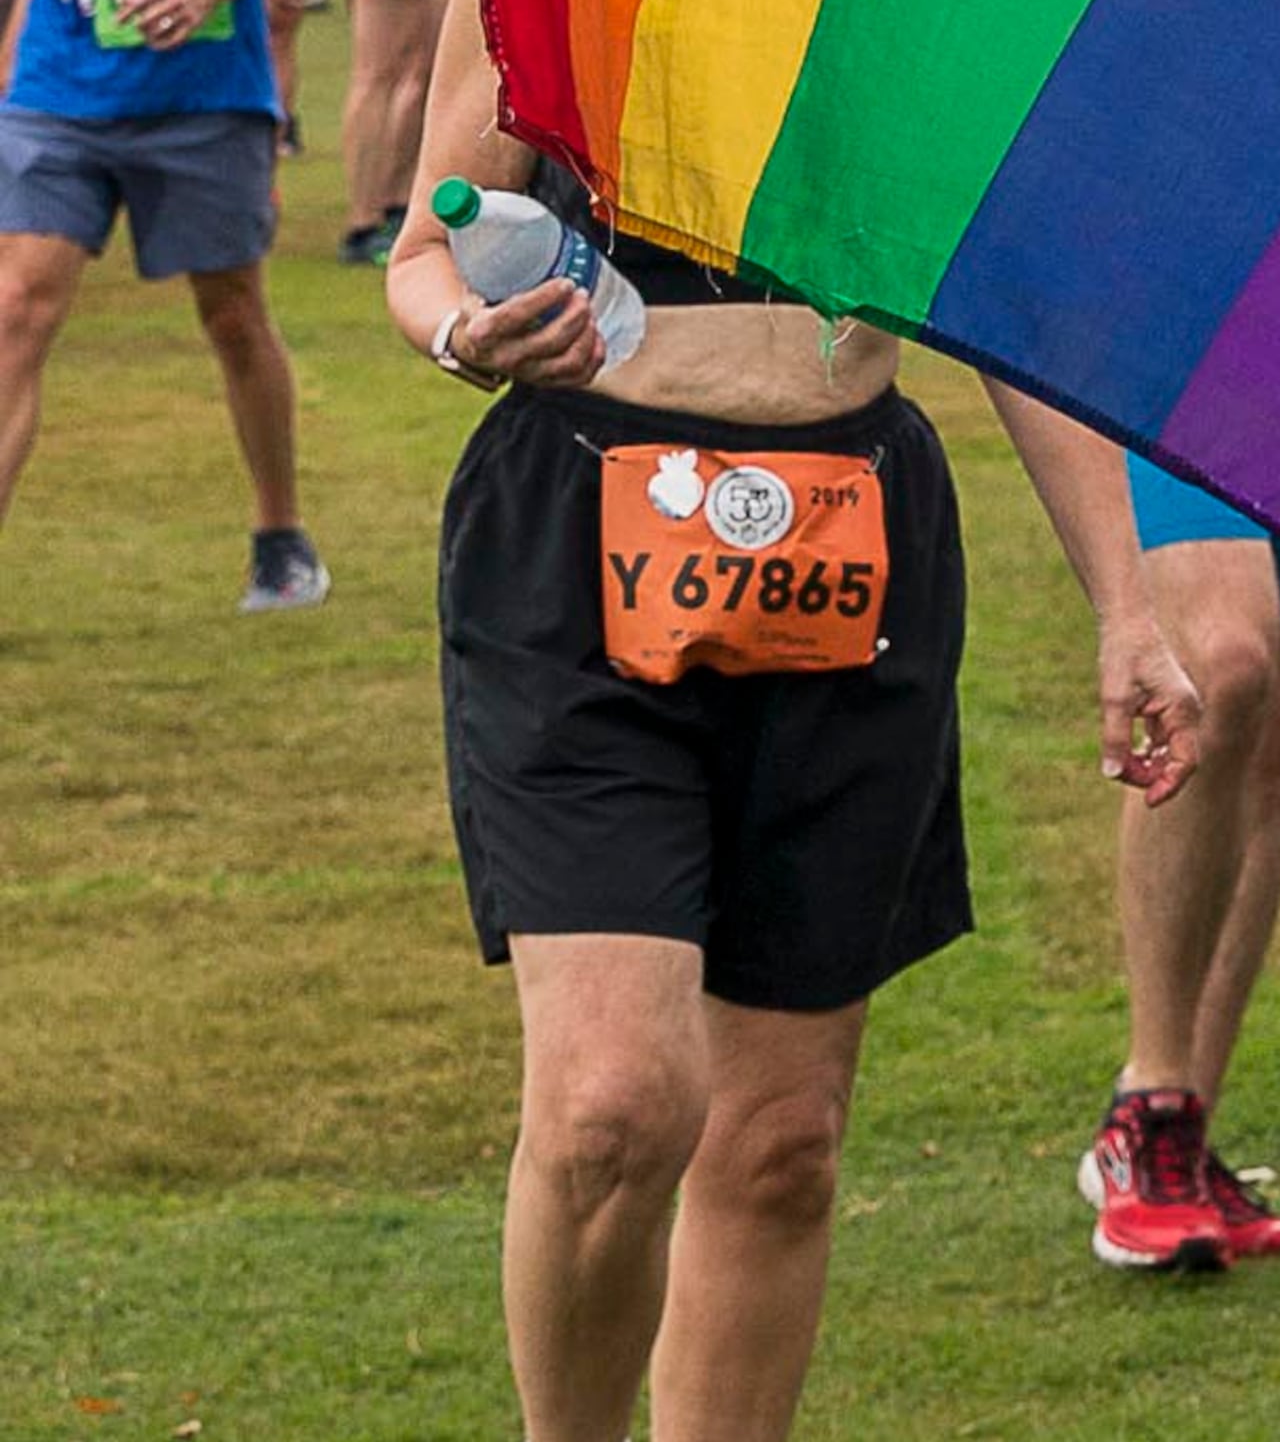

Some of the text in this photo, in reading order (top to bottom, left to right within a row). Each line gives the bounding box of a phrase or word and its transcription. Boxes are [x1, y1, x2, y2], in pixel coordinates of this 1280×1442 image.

[810, 485, 860, 507] 2019
[608, 553, 874, 618] Y 67865
